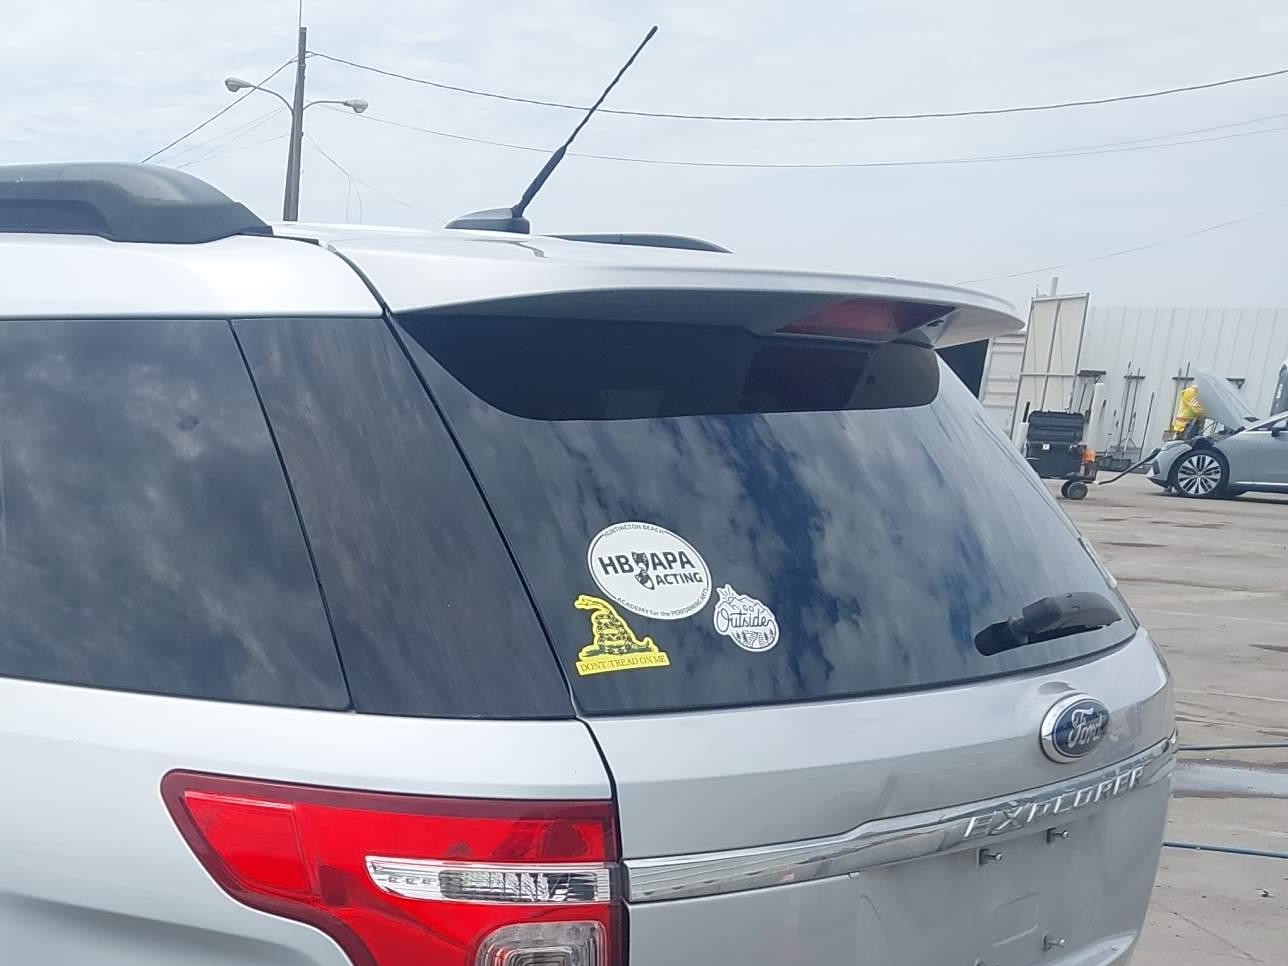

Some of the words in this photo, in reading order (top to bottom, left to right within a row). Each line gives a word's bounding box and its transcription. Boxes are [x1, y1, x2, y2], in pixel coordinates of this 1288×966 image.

[598, 554, 634, 575] HB
[650, 550, 696, 570] APA
[655, 572, 704, 585] ACTING
[617, 597, 648, 615] ACADEMY
[743, 604, 755, 612] GO
[717, 607, 769, 632] Outside
[608, 657, 638, 667] TREAD
[639, 656, 653, 664] ON
[653, 655, 667, 663] ME
[1067, 708, 1105, 748] Ford
[964, 766, 1145, 838] EXPLORER
